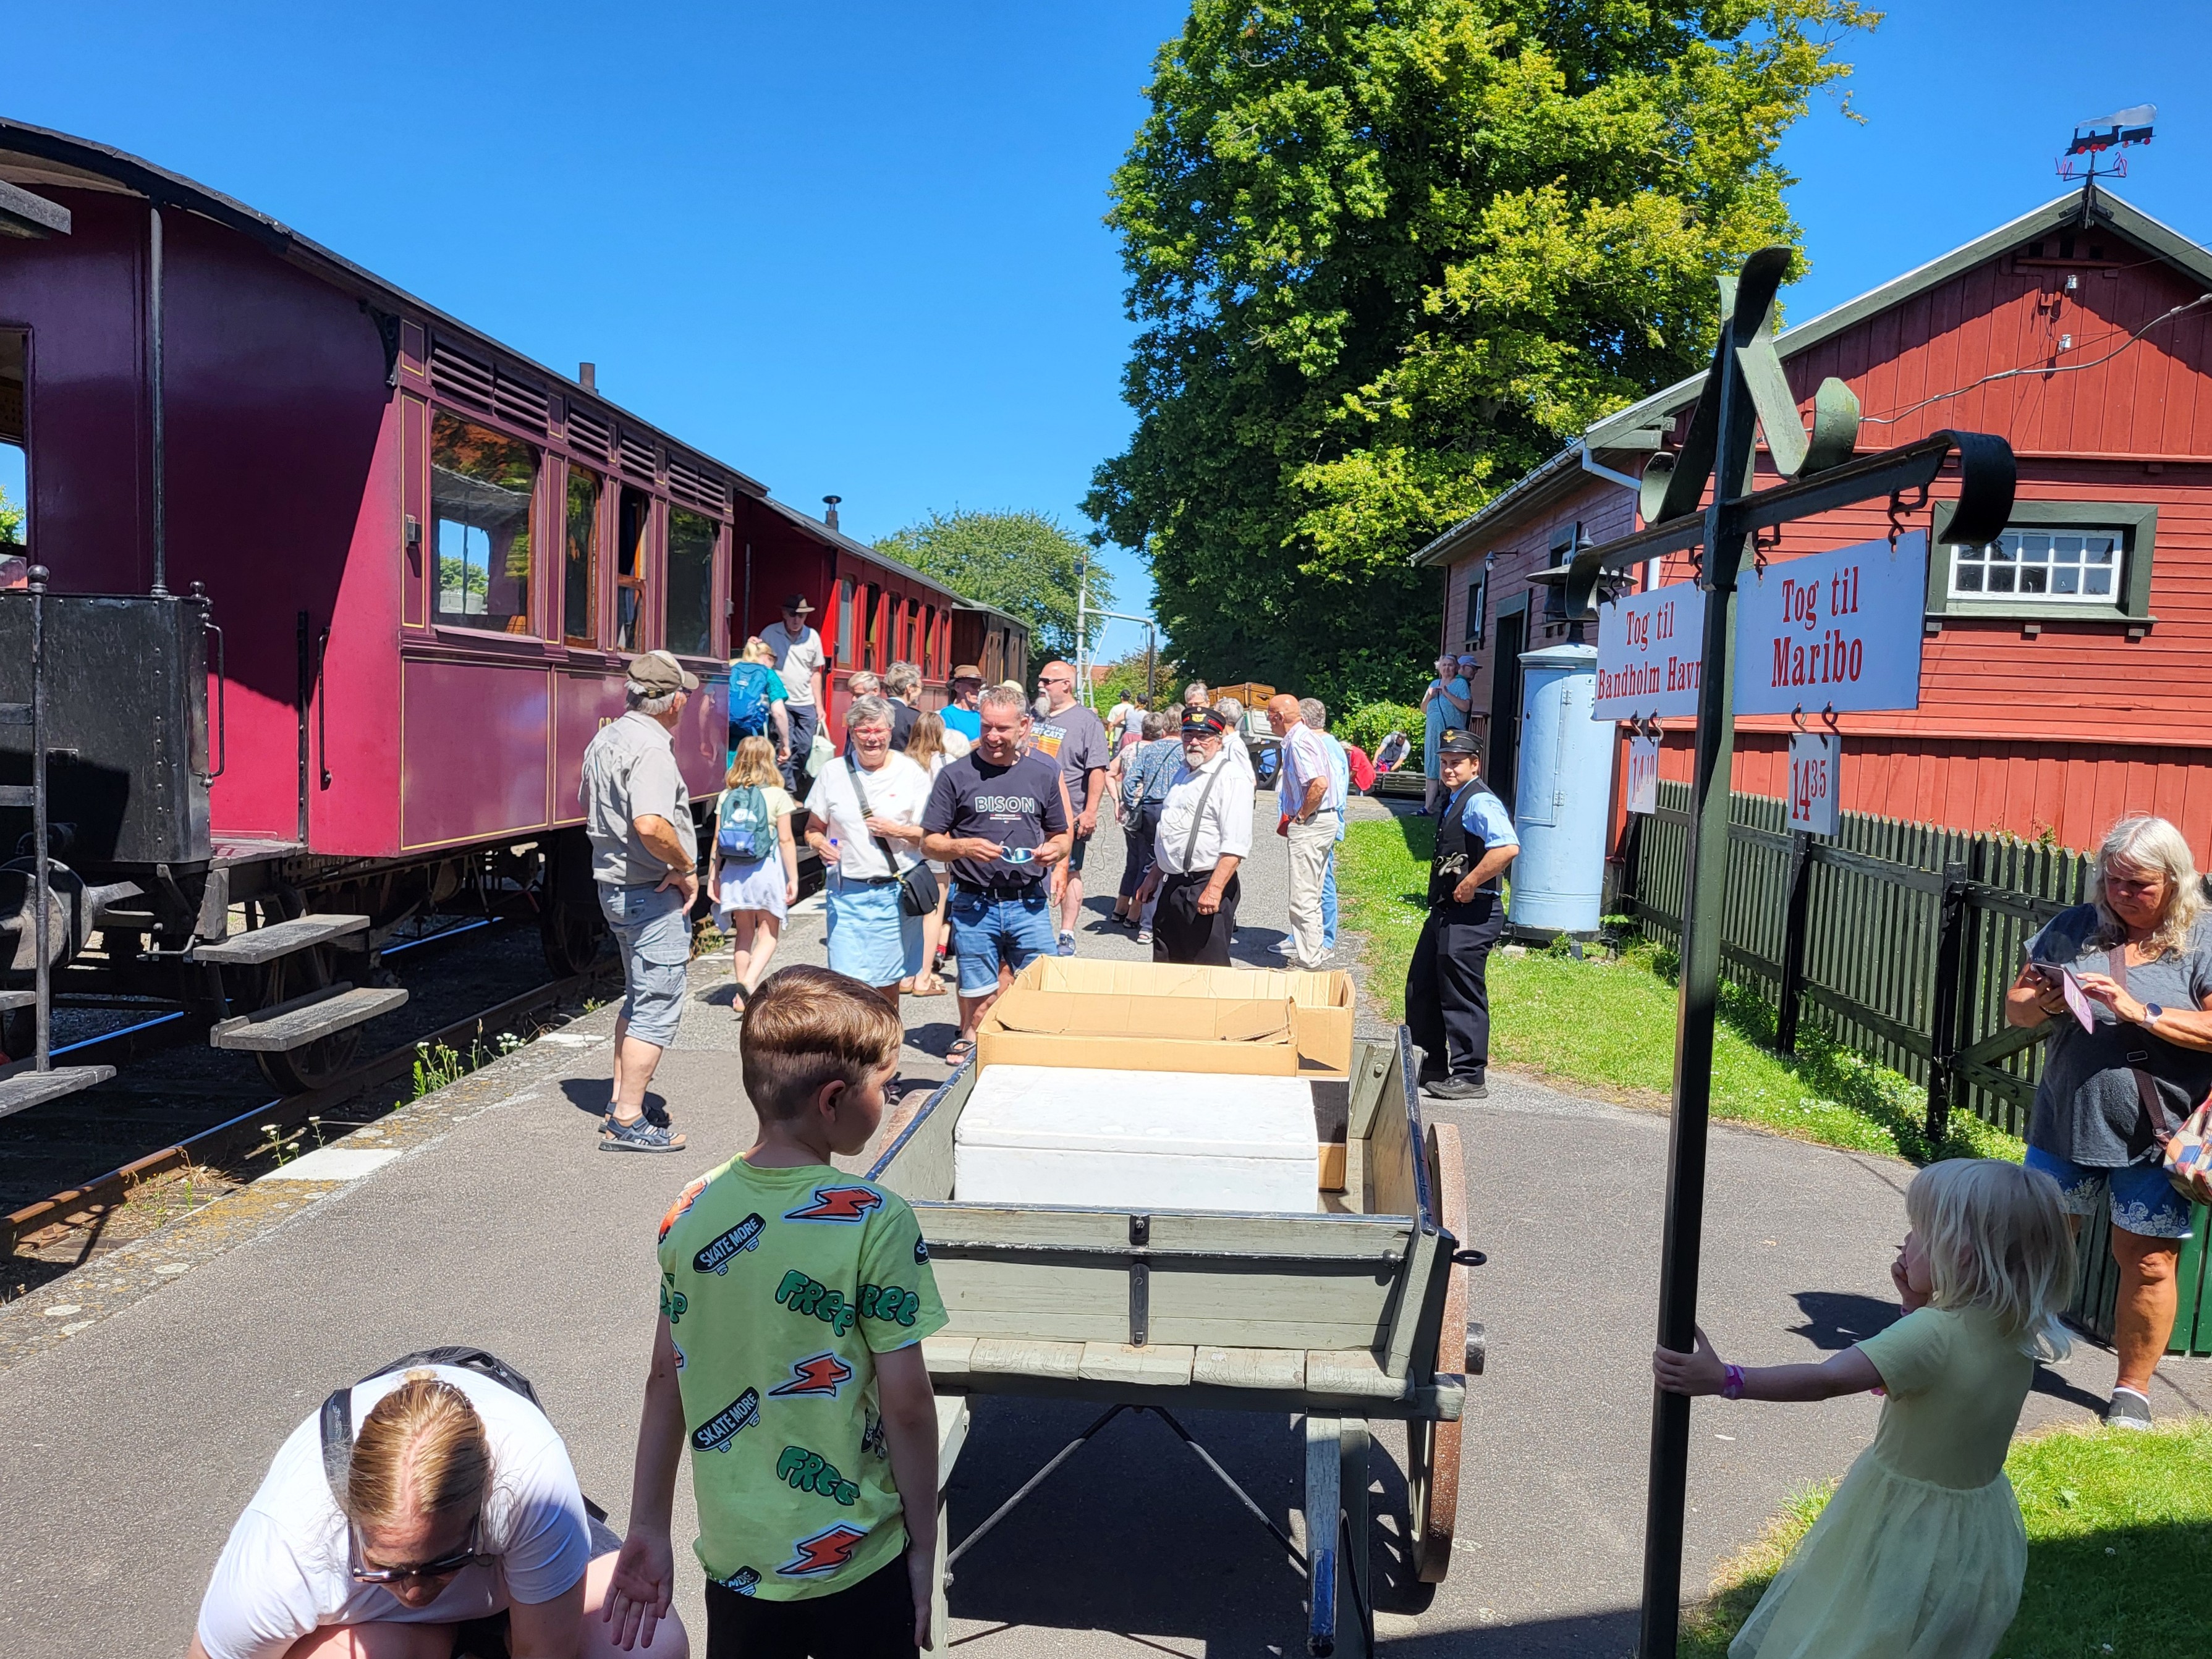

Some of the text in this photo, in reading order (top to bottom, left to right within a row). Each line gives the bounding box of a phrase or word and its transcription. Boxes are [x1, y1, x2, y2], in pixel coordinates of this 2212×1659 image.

[1782, 566, 1858, 631] Tog til
[1626, 601, 1674, 651] Tog til
[1597, 661, 1660, 700] Bandholm
[1771, 628, 1863, 688] Maribo
[1043, 729, 1065, 740] CATS
[975, 795, 1035, 814] BISON
[700, 1218, 759, 1267] SKATE MORE
[697, 1393, 756, 1446] SKATE MORE
